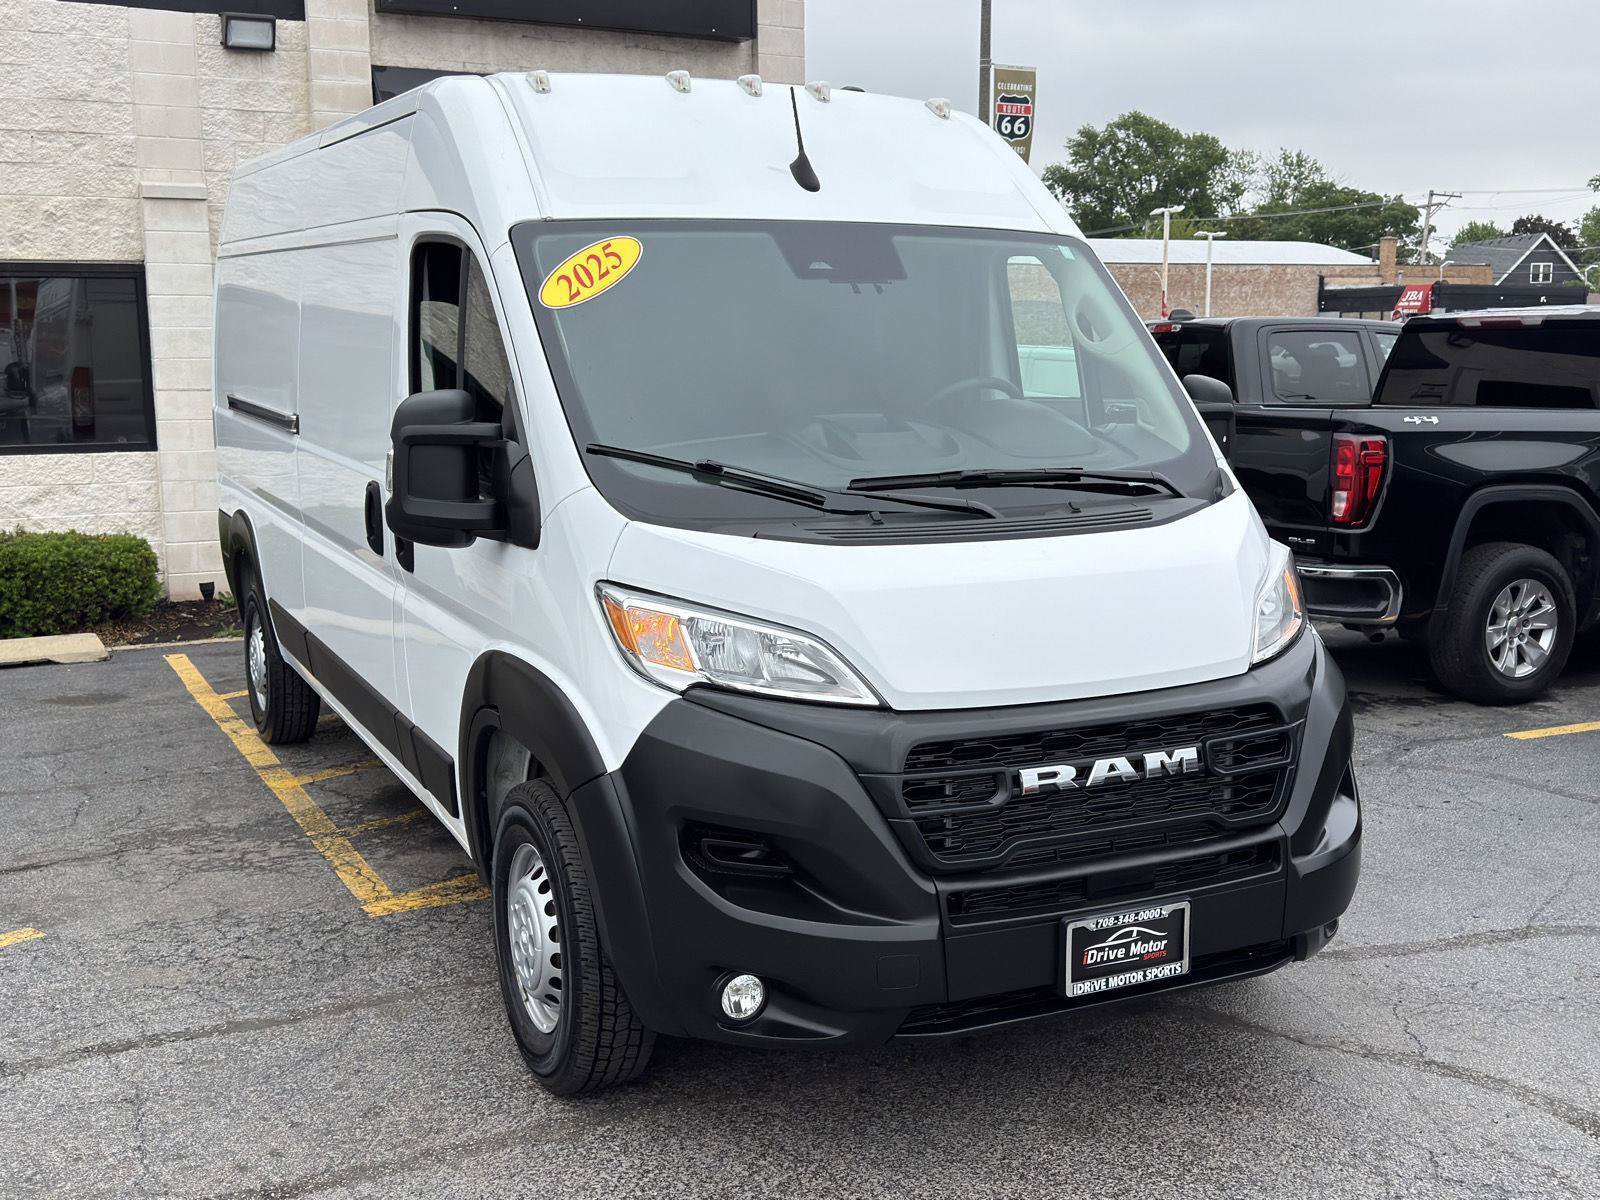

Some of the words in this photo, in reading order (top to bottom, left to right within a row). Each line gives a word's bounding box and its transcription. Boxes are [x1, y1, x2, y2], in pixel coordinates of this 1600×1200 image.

[997, 82, 1033, 91] CELEBRATING
[1002, 104, 1025, 114] ROUTE
[1001, 116, 1026, 135] 66
[556, 242, 622, 302] 2025
[1401, 290, 1424, 301] JBA
[1018, 746, 1199, 796] RAM
[1097, 908, 1161, 929] 708-348-0000
[1082, 947, 1126, 966] iDrive
[1129, 939, 1168, 957] Motor
[1143, 950, 1168, 961] SPORTS
[1108, 971, 1144, 988] MOTOR
[1145, 962, 1182, 980] SPORTS
